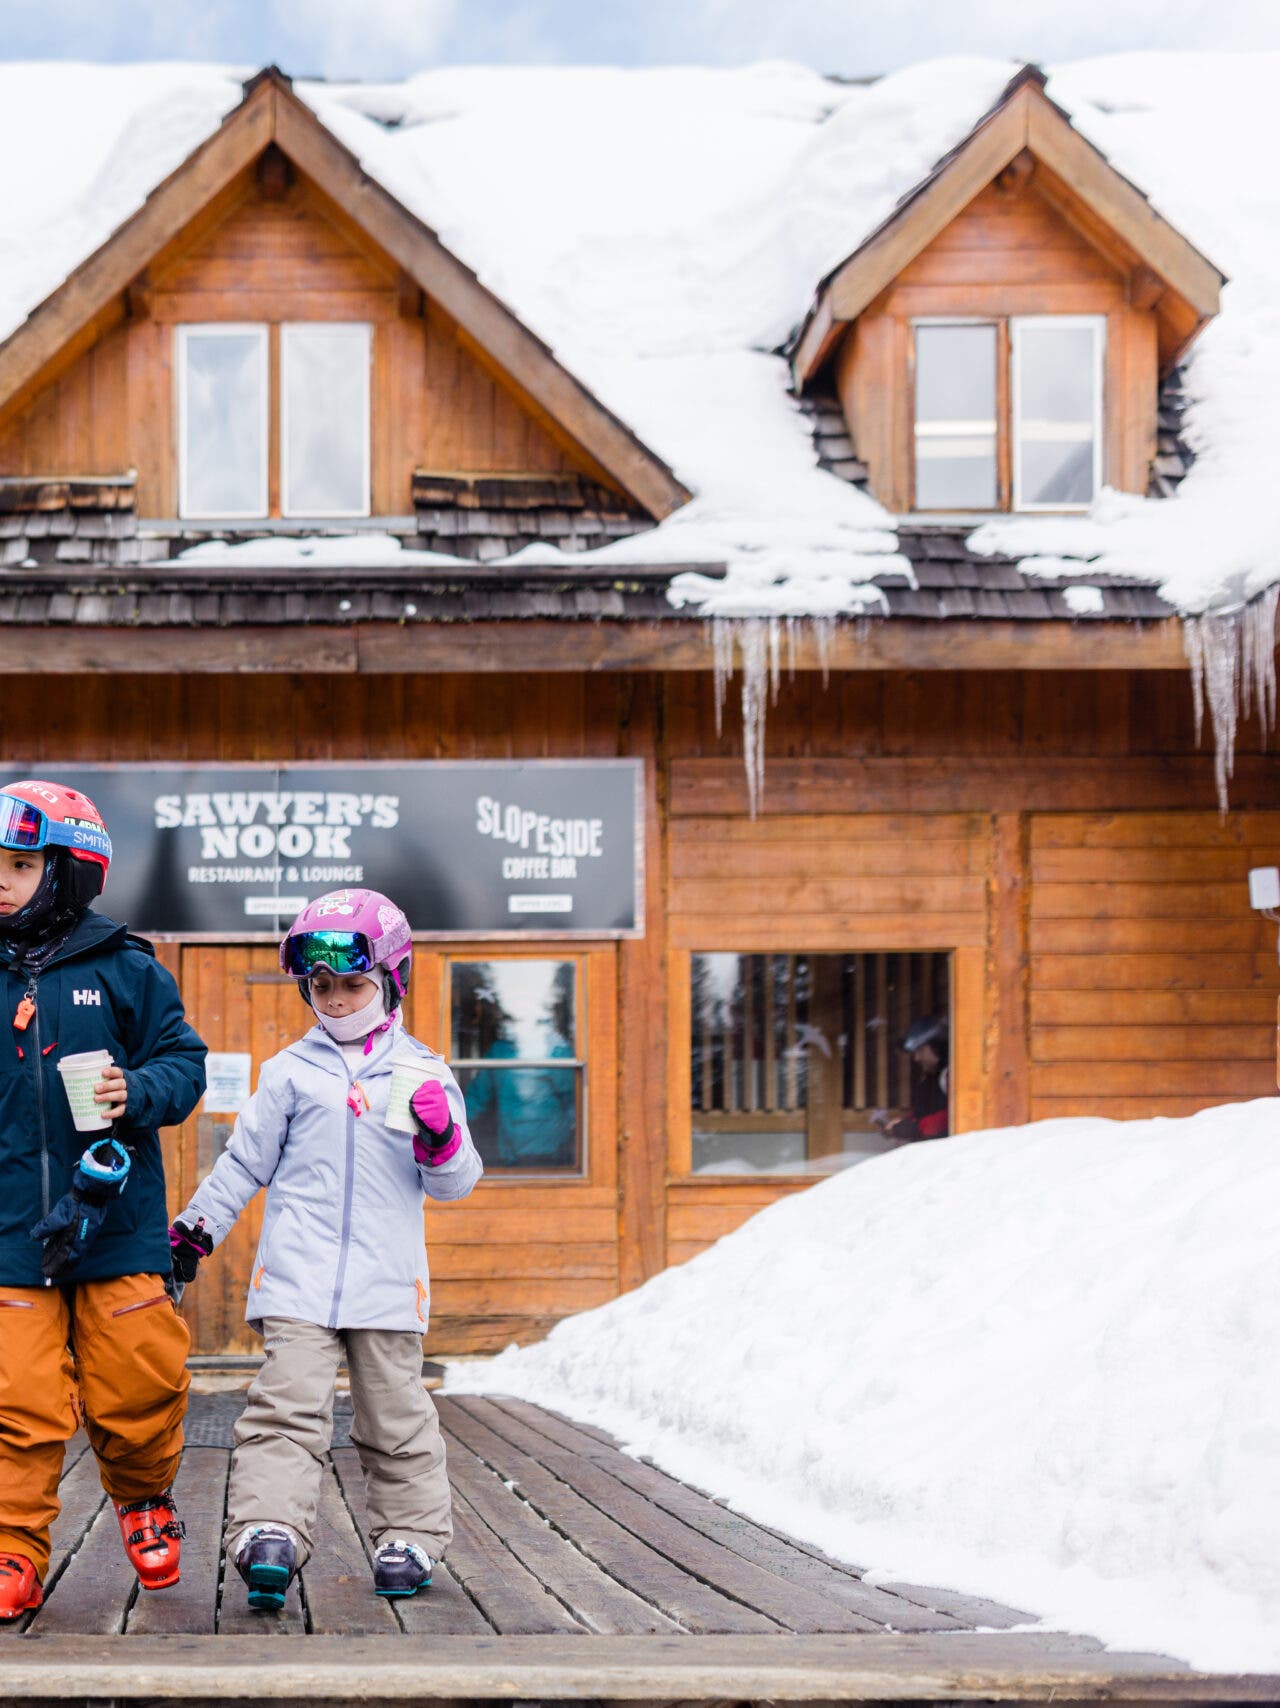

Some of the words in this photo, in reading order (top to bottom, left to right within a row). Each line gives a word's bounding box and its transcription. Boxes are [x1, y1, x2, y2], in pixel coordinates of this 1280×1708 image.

[154, 791, 400, 828] SAWYER'S
[477, 796, 603, 857] SLOPESIDE
[73, 831, 109, 850] SMITH
[200, 824, 352, 859] NOOK
[188, 866, 284, 882] RESTAURANT
[286, 867, 299, 882] &
[303, 866, 364, 882] LOUNGE
[502, 857, 549, 879] COFFEE
[550, 857, 577, 878] BAR
[73, 989, 101, 1006] HH
